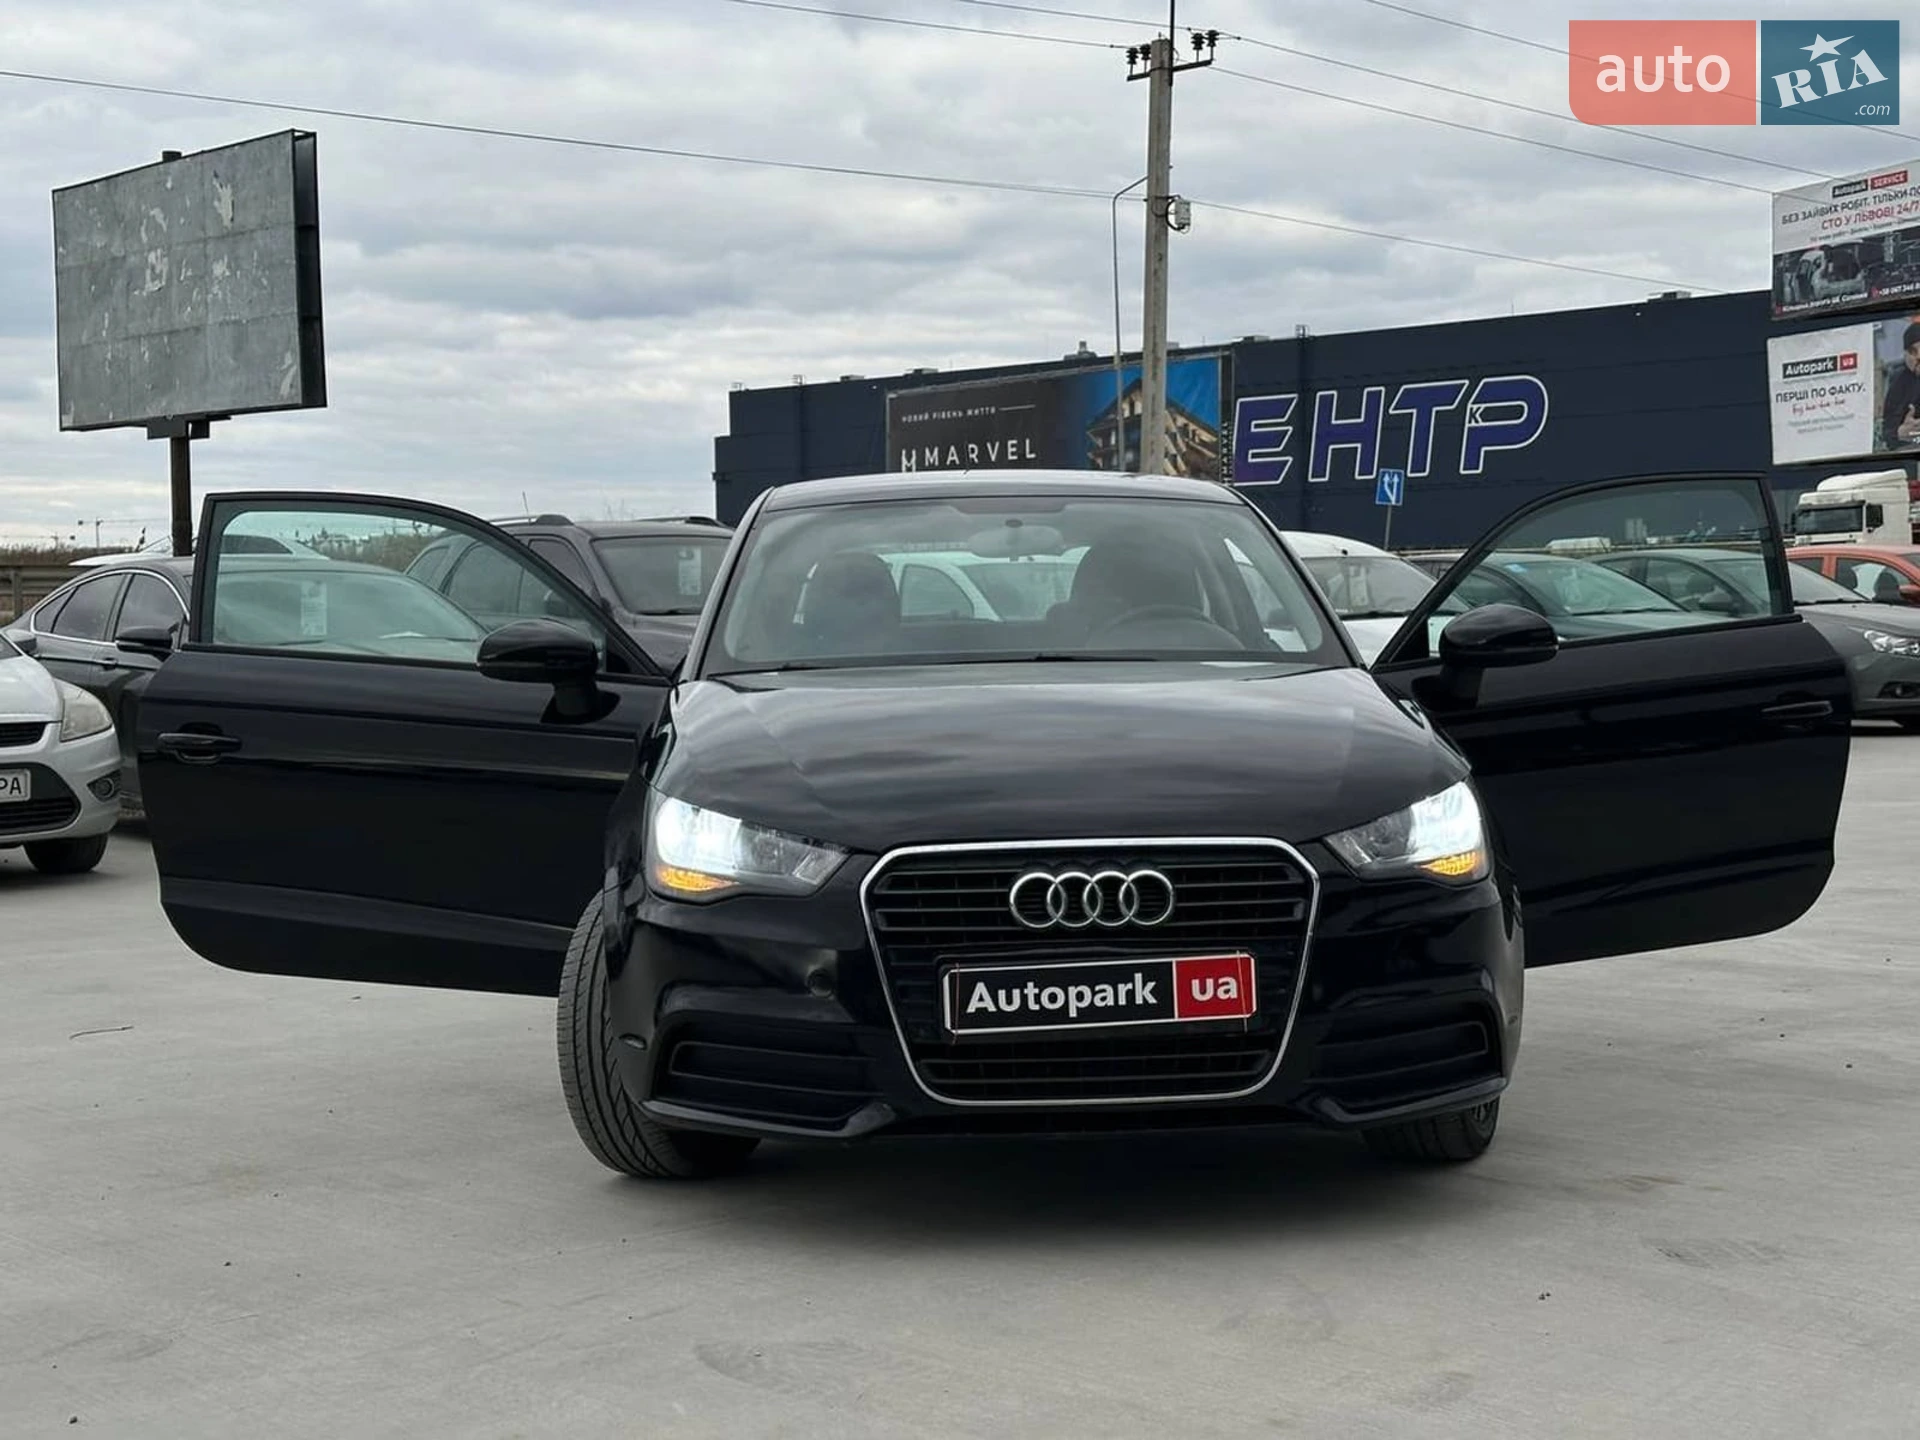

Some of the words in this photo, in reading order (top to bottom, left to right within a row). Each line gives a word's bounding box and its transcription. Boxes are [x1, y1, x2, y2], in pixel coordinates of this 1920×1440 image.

[1822, 217, 1843, 230] СТО
[1844, 215, 1852, 226] У
[1854, 206, 1894, 223] ЛЬВОВІ
[1785, 358, 1834, 376] Autopark
[1776, 390, 1809, 404] ПЕРШІ
[1811, 388, 1826, 399] ПО
[924, 438, 1037, 467] MARVEL
[966, 972, 1158, 1018] Autopark
[1190, 974, 1239, 1002] ua
